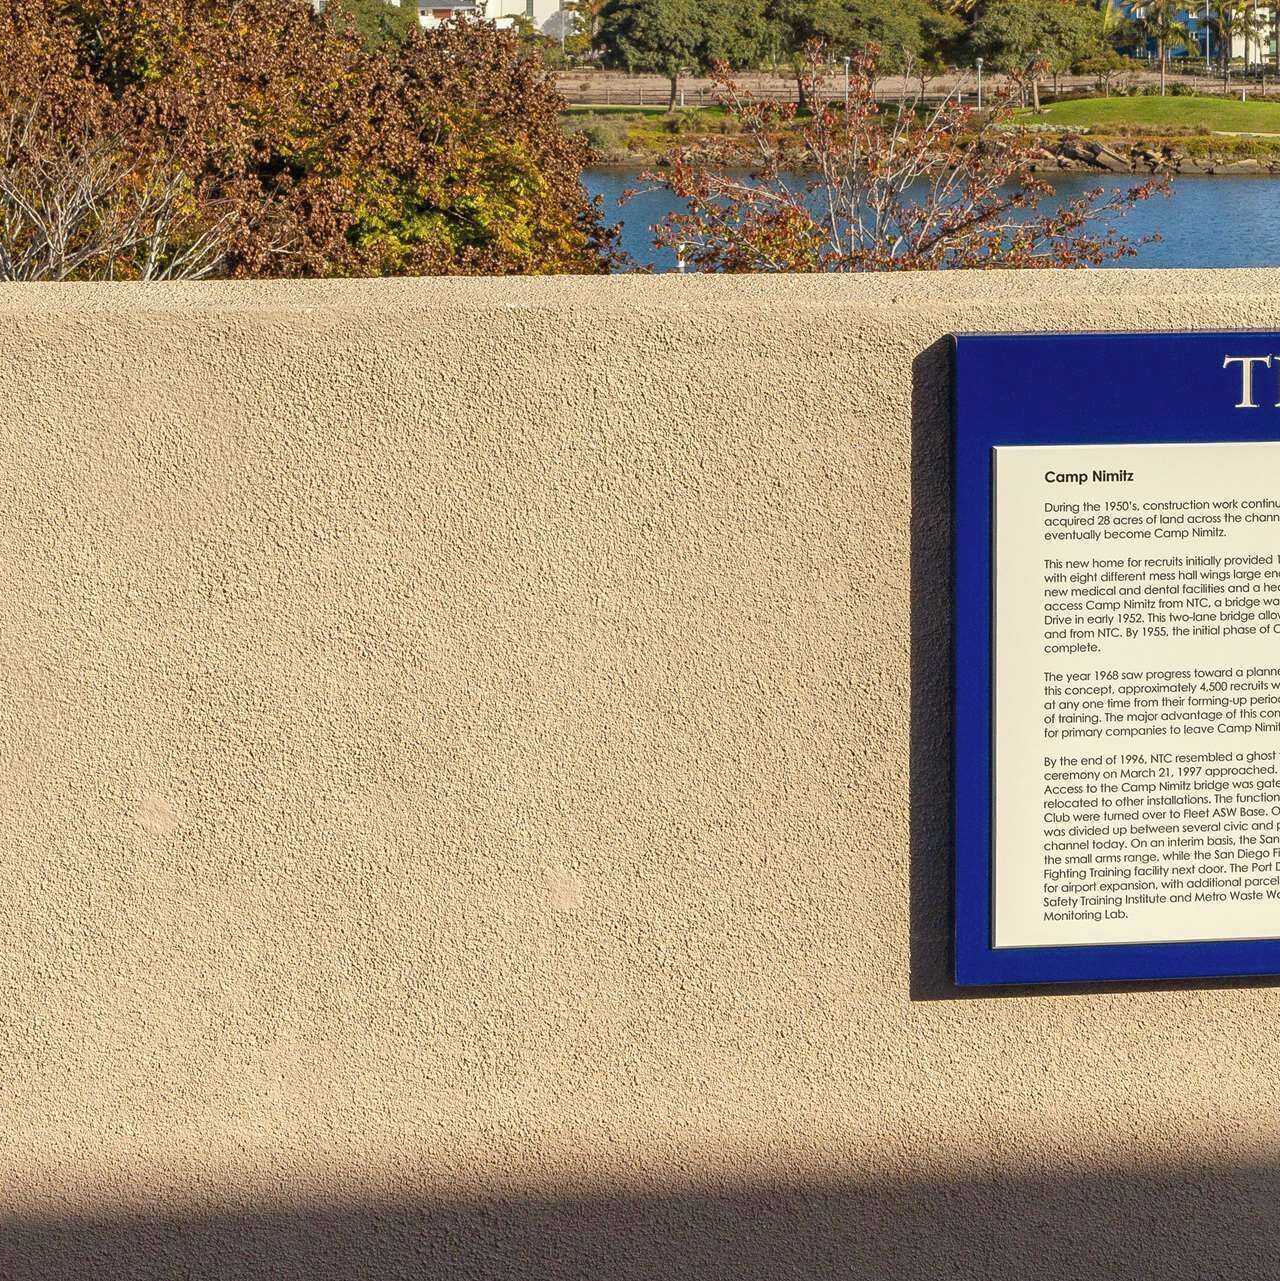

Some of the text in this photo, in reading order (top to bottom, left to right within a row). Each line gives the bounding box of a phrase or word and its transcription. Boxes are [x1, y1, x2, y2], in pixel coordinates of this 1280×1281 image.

[1044, 470, 1133, 486] Camp Nimitz
[1044, 502, 1079, 515] During
[1082, 501, 1100, 512] the
[1105, 501, 1139, 513] 1950's,
[1142, 500, 1209, 510] construction
[1212, 499, 1238, 509] work
[1044, 516, 1094, 529] acquired
[1097, 515, 1110, 525] 28
[1112, 517, 1143, 525] acres
[1145, 514, 1157, 524] of
[1159, 514, 1184, 524] land
[1186, 516, 1221, 524] across
[1223, 513, 1242, 523] the
[1044, 559, 1063, 569] This
[1065, 561, 1089, 569] new
[1092, 558, 1124, 568] home
[1127, 557, 1142, 567] for
[1144, 556, 1183, 567] recruits
[1185, 556, 1221, 568] initially
[1224, 555, 1272, 568] provided
[1043, 573, 1066, 583] with
[1069, 572, 1097, 585] eight
[1100, 571, 1145, 582] different
[1149, 573, 1175, 581] mess
[1178, 570, 1197, 580] hall
[1199, 569, 1230, 582] wings
[1233, 569, 1261, 581] large
[1044, 628, 1066, 639] and
[1069, 628, 1094, 638] from
[1097, 627, 1122, 638] NTC.
[1125, 627, 1138, 639] By
[1142, 626, 1168, 639] 1955,
[1172, 626, 1190, 636] the
[1192, 625, 1220, 635] initial
[1223, 624, 1256, 637] phase
[1259, 624, 1270, 634] of
[1044, 642, 1100, 656] complete.
[1043, 672, 1063, 682] The
[1066, 673, 1091, 684] year
[1095, 670, 1119, 680] 1968
[1121, 672, 1143, 680] saw
[1145, 671, 1191, 682] progress
[1194, 667, 1232, 678] toward
[1235, 669, 1243, 677] a
[1044, 728, 1059, 738] for
[1061, 726, 1102, 740] primary
[1105, 725, 1167, 738] companies
[1169, 724, 1180, 734] to
[1183, 723, 1214, 734] leave
[1217, 723, 1252, 735] Camp
[1044, 756, 1056, 769] By
[1059, 756, 1077, 766] the
[1080, 755, 1102, 765] end
[1105, 755, 1117, 765] of
[1121, 754, 1147, 767] 1996,
[1150, 753, 1172, 764] NTC
[1175, 752, 1232, 763] resembled
[1246, 750, 1276, 763] ghost
[1043, 771, 1100, 783] ceremony
[1102, 771, 1117, 779] on
[1120, 768, 1155, 778] March
[1158, 767, 1173, 780] 21,
[1178, 766, 1202, 777] 1997
[1205, 764, 1277, 778] approached.
[1043, 896, 1078, 909] Safety
[1079, 894, 1122, 908] Training
[1125, 893, 1166, 904] Institute
[1169, 892, 1191, 903] and
[1194, 891, 1226, 902] Metro
[1229, 890, 1263, 901] Waste
[1043, 909, 1128, 924] Monitoring Lab.
